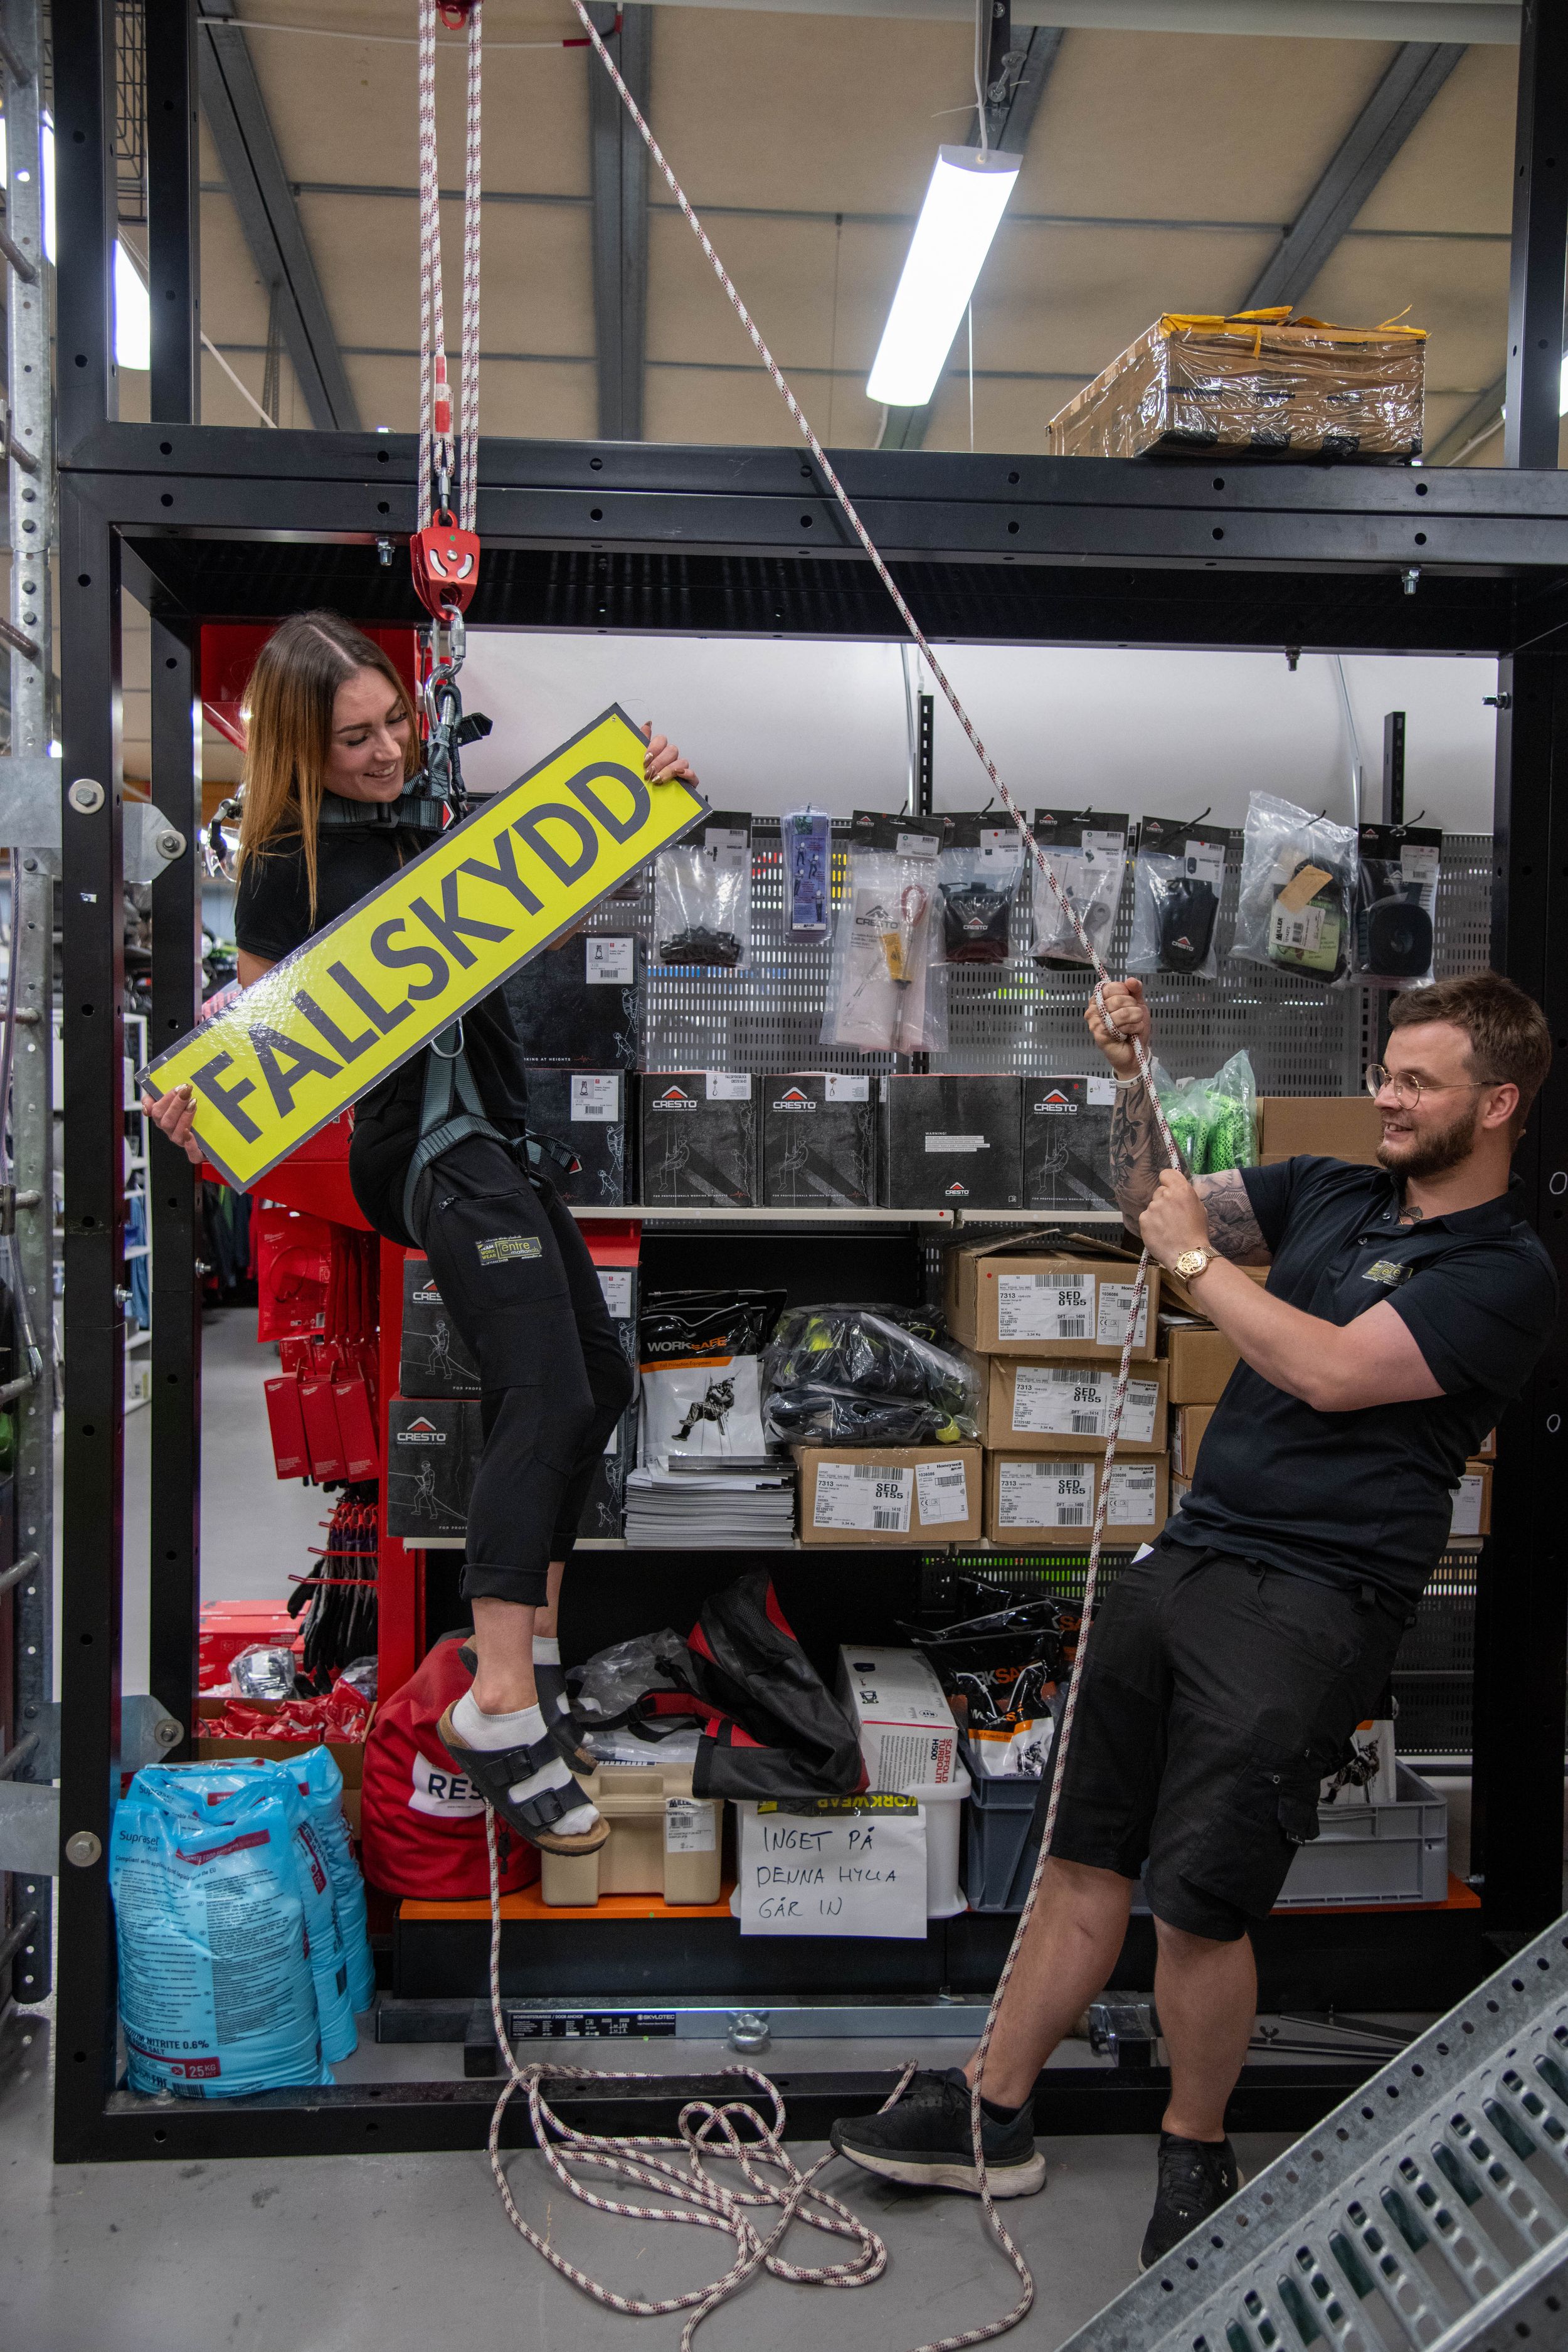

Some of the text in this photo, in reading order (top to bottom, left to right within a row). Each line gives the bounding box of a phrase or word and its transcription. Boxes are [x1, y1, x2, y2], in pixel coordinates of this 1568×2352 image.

[1172, 941, 1194, 951] CRESTO
[190, 761, 651, 1145] FALLSKYDD
[502, 1242, 530, 1252] entre
[1059, 1291, 1080, 1300] SED
[647, 1336, 727, 1352] WORKSAFE
[1074, 1387, 1096, 1396] SED
[876, 1483, 898, 1492] SED
[1059, 1480, 1080, 1488] SED
[931, 1739, 939, 1760] H500
[669, 1799, 692, 1808] MILLE
[119, 1830, 158, 1845] Suprasel
[764, 1826, 875, 1851] INGET PÅ
[757, 1866, 896, 1887] DENNA HYLLA
[759, 1897, 842, 1918] GÅR IN
[147, 2037, 209, 2049] NITRITE 0.6%
[149, 2047, 165, 2055] SALT
[189, 2066, 204, 2078] 25
